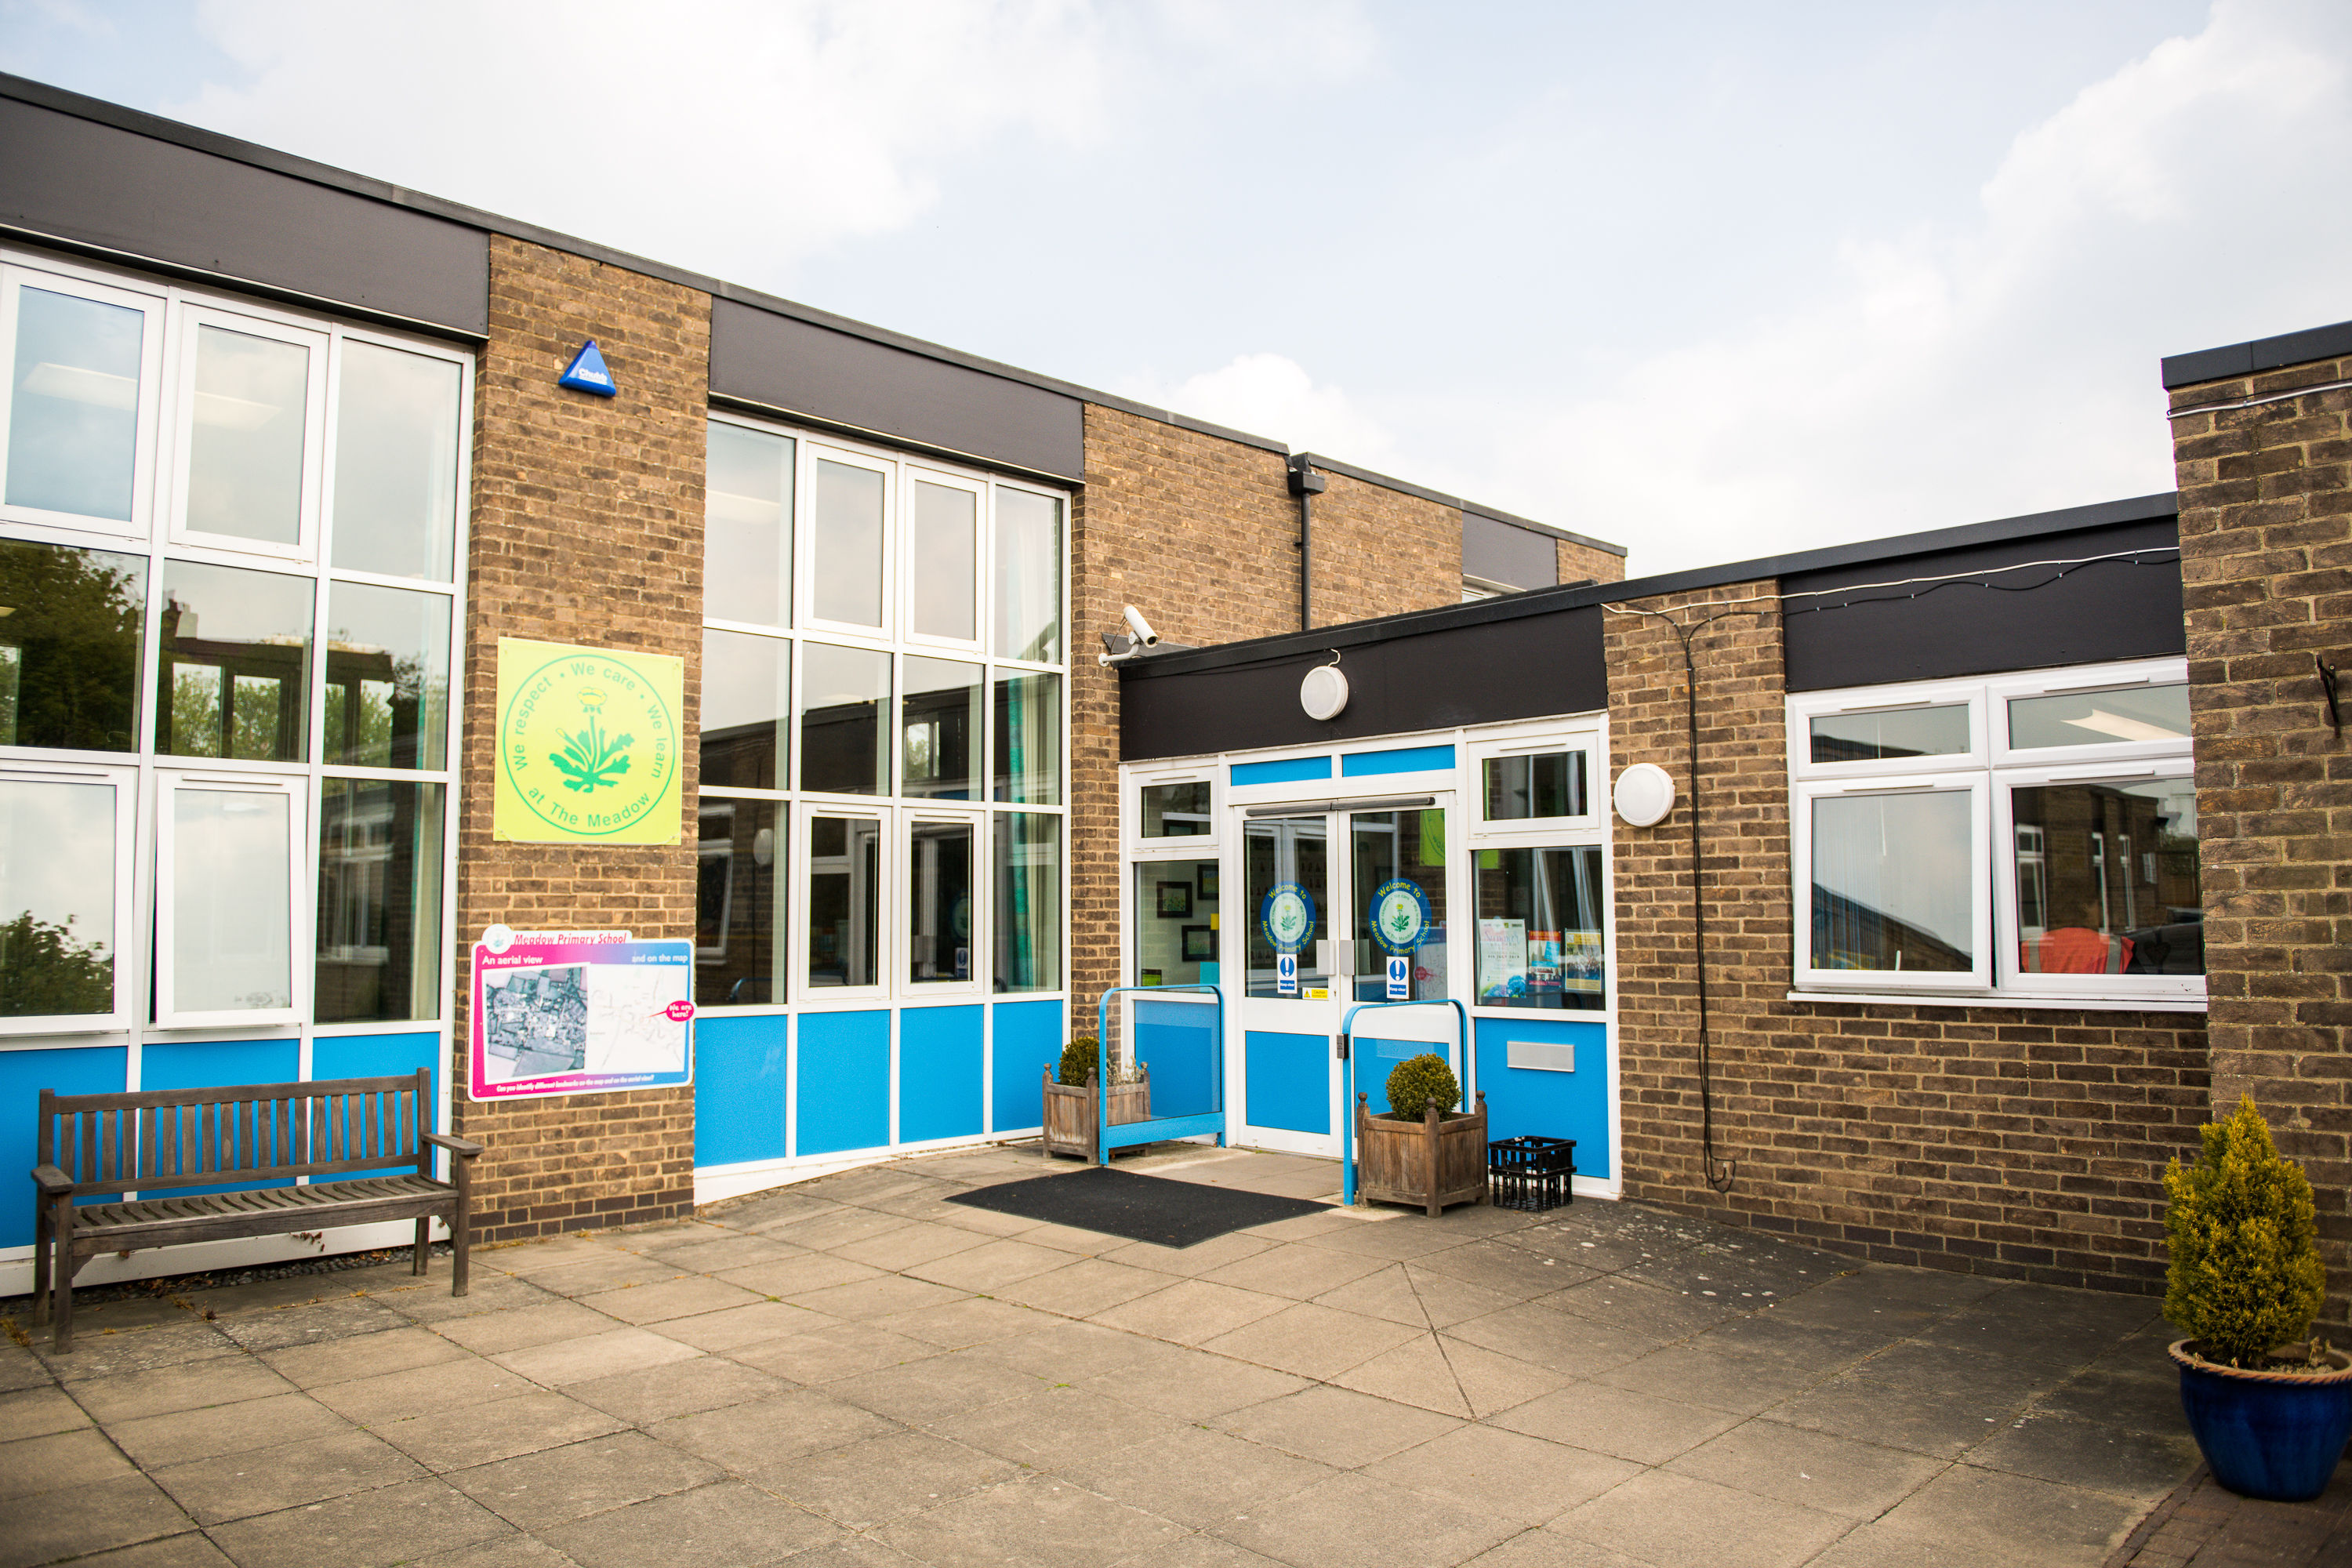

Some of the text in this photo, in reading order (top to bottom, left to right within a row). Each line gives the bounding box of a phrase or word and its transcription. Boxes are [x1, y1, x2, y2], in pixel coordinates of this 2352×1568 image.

[571, 662, 635, 691] We care
[514, 677, 552, 771] We respect
[647, 705, 667, 779] We learn
[528, 787, 649, 826] at The Meadow
[1269, 884, 1298, 898] Welcome
[1300, 890, 1306, 899] to
[1377, 882, 1421, 898] Welcome to
[514, 933, 626, 946] Meadow Primary School
[1262, 920, 1277, 946] Meadow
[1302, 921, 1314, 945] School
[1371, 920, 1430, 954] Meadow Primary School
[482, 956, 543, 965] An aerial view
[632, 954, 646, 963] and
[659, 953, 671, 962] the
[673, 955, 688, 964] map
